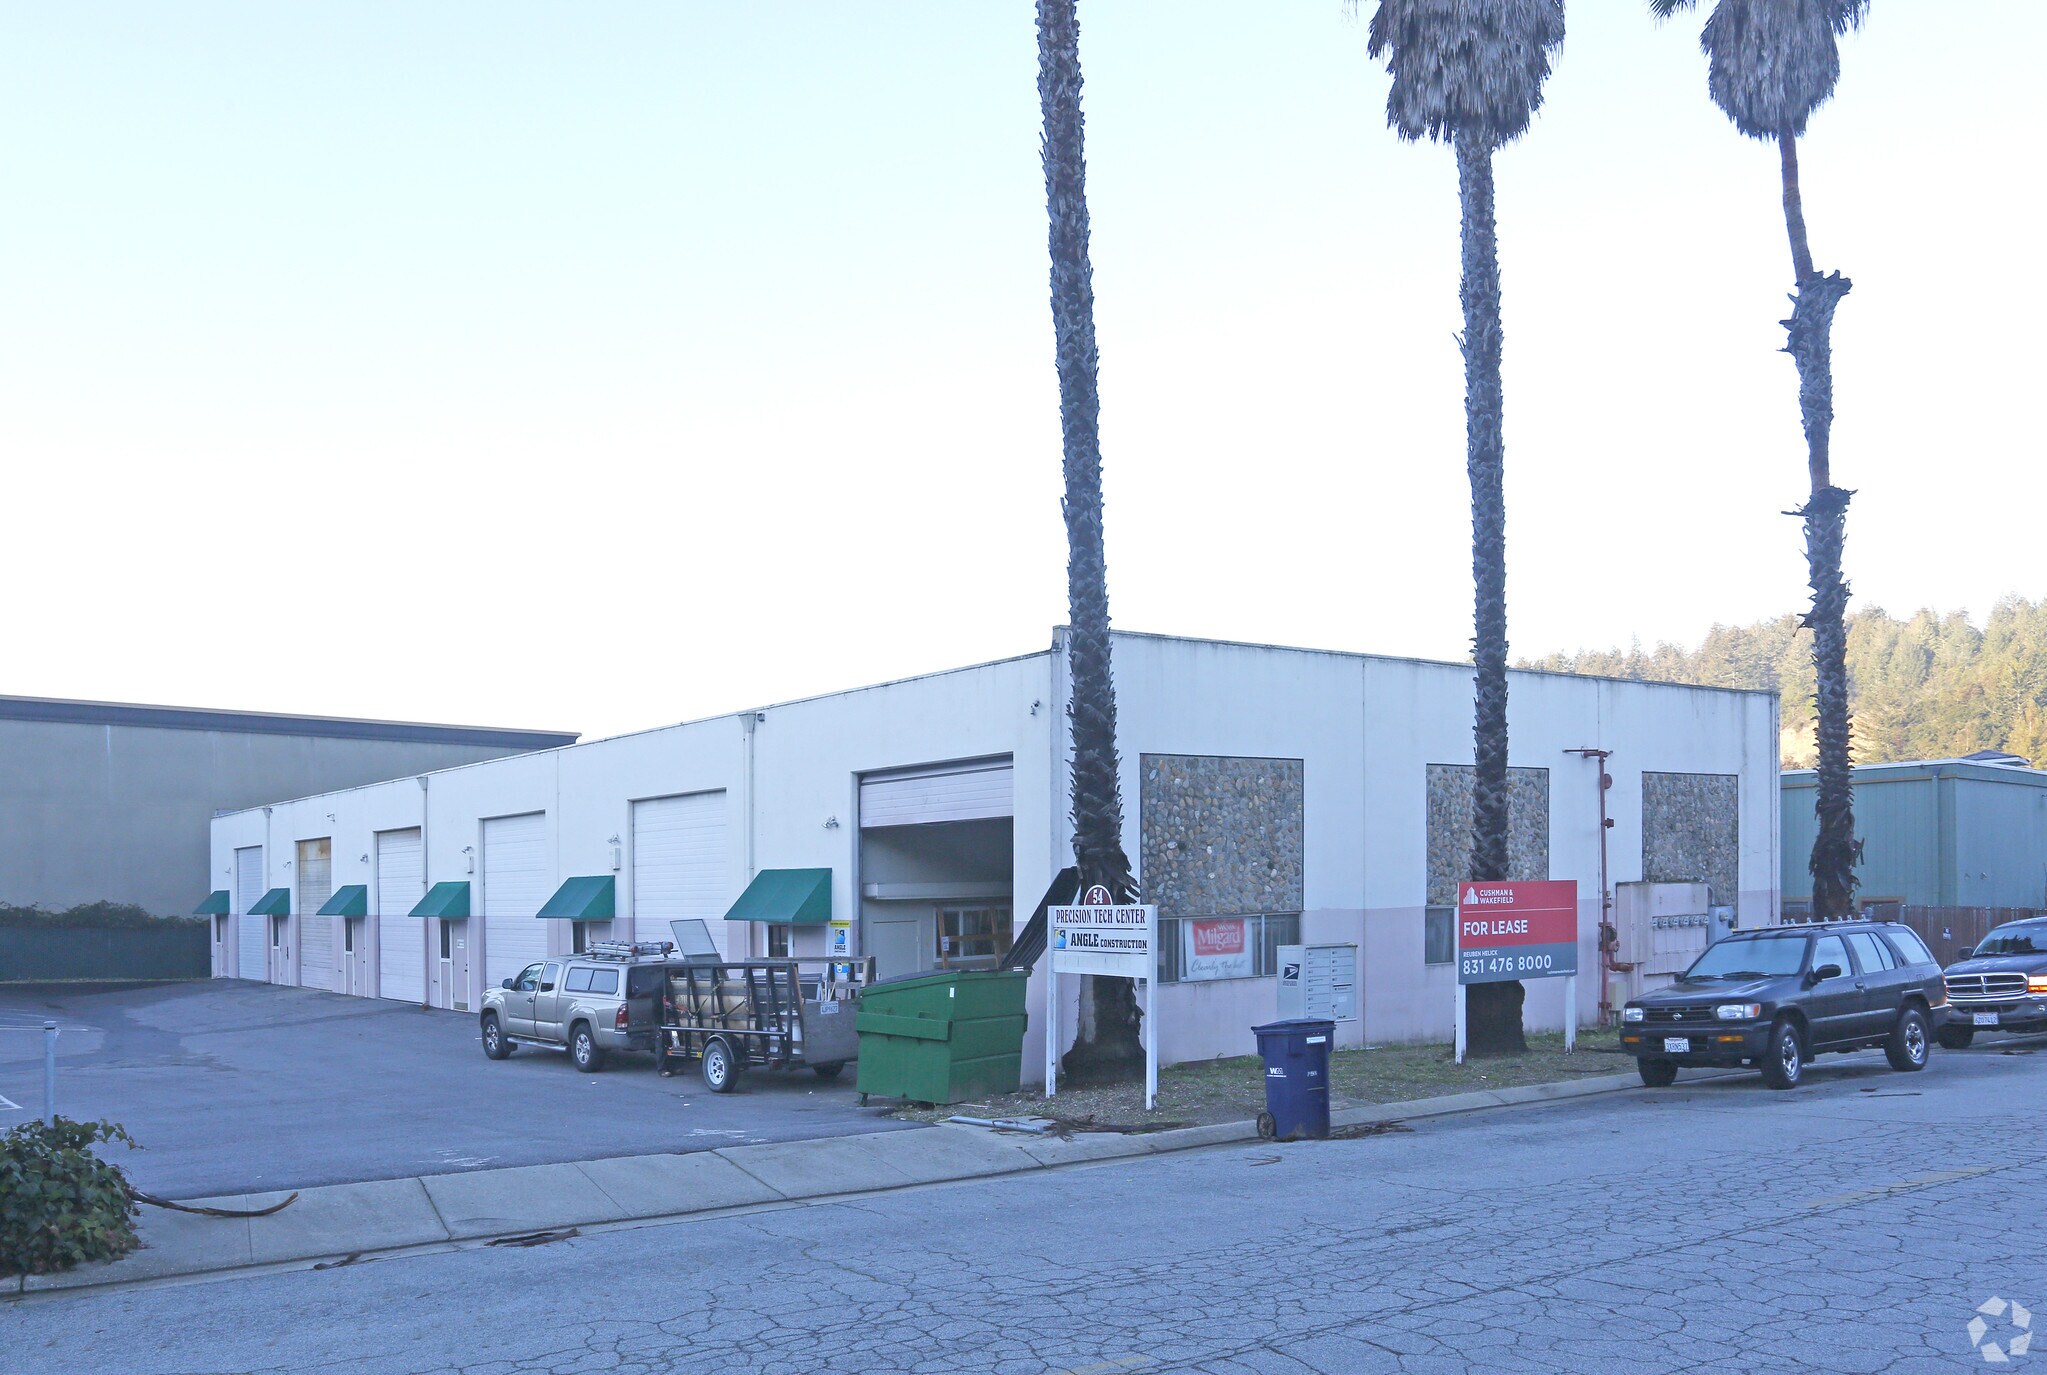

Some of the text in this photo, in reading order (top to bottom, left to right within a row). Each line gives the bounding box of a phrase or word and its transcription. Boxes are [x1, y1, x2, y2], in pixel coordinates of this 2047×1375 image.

[1092, 888, 1104, 905] 54
[1480, 888, 1513, 897] CUSHMAN &
[1480, 896, 1514, 905] WAKEFIELD
[1055, 908, 1146, 925] PRECISION TECH CENTER
[1463, 919, 1528, 936] FOR LEASE
[1070, 933, 1148, 949] ANGLE CONSTRUCTION
[1198, 925, 1241, 951] Milgard
[1463, 954, 1552, 975] 831 476 8000
